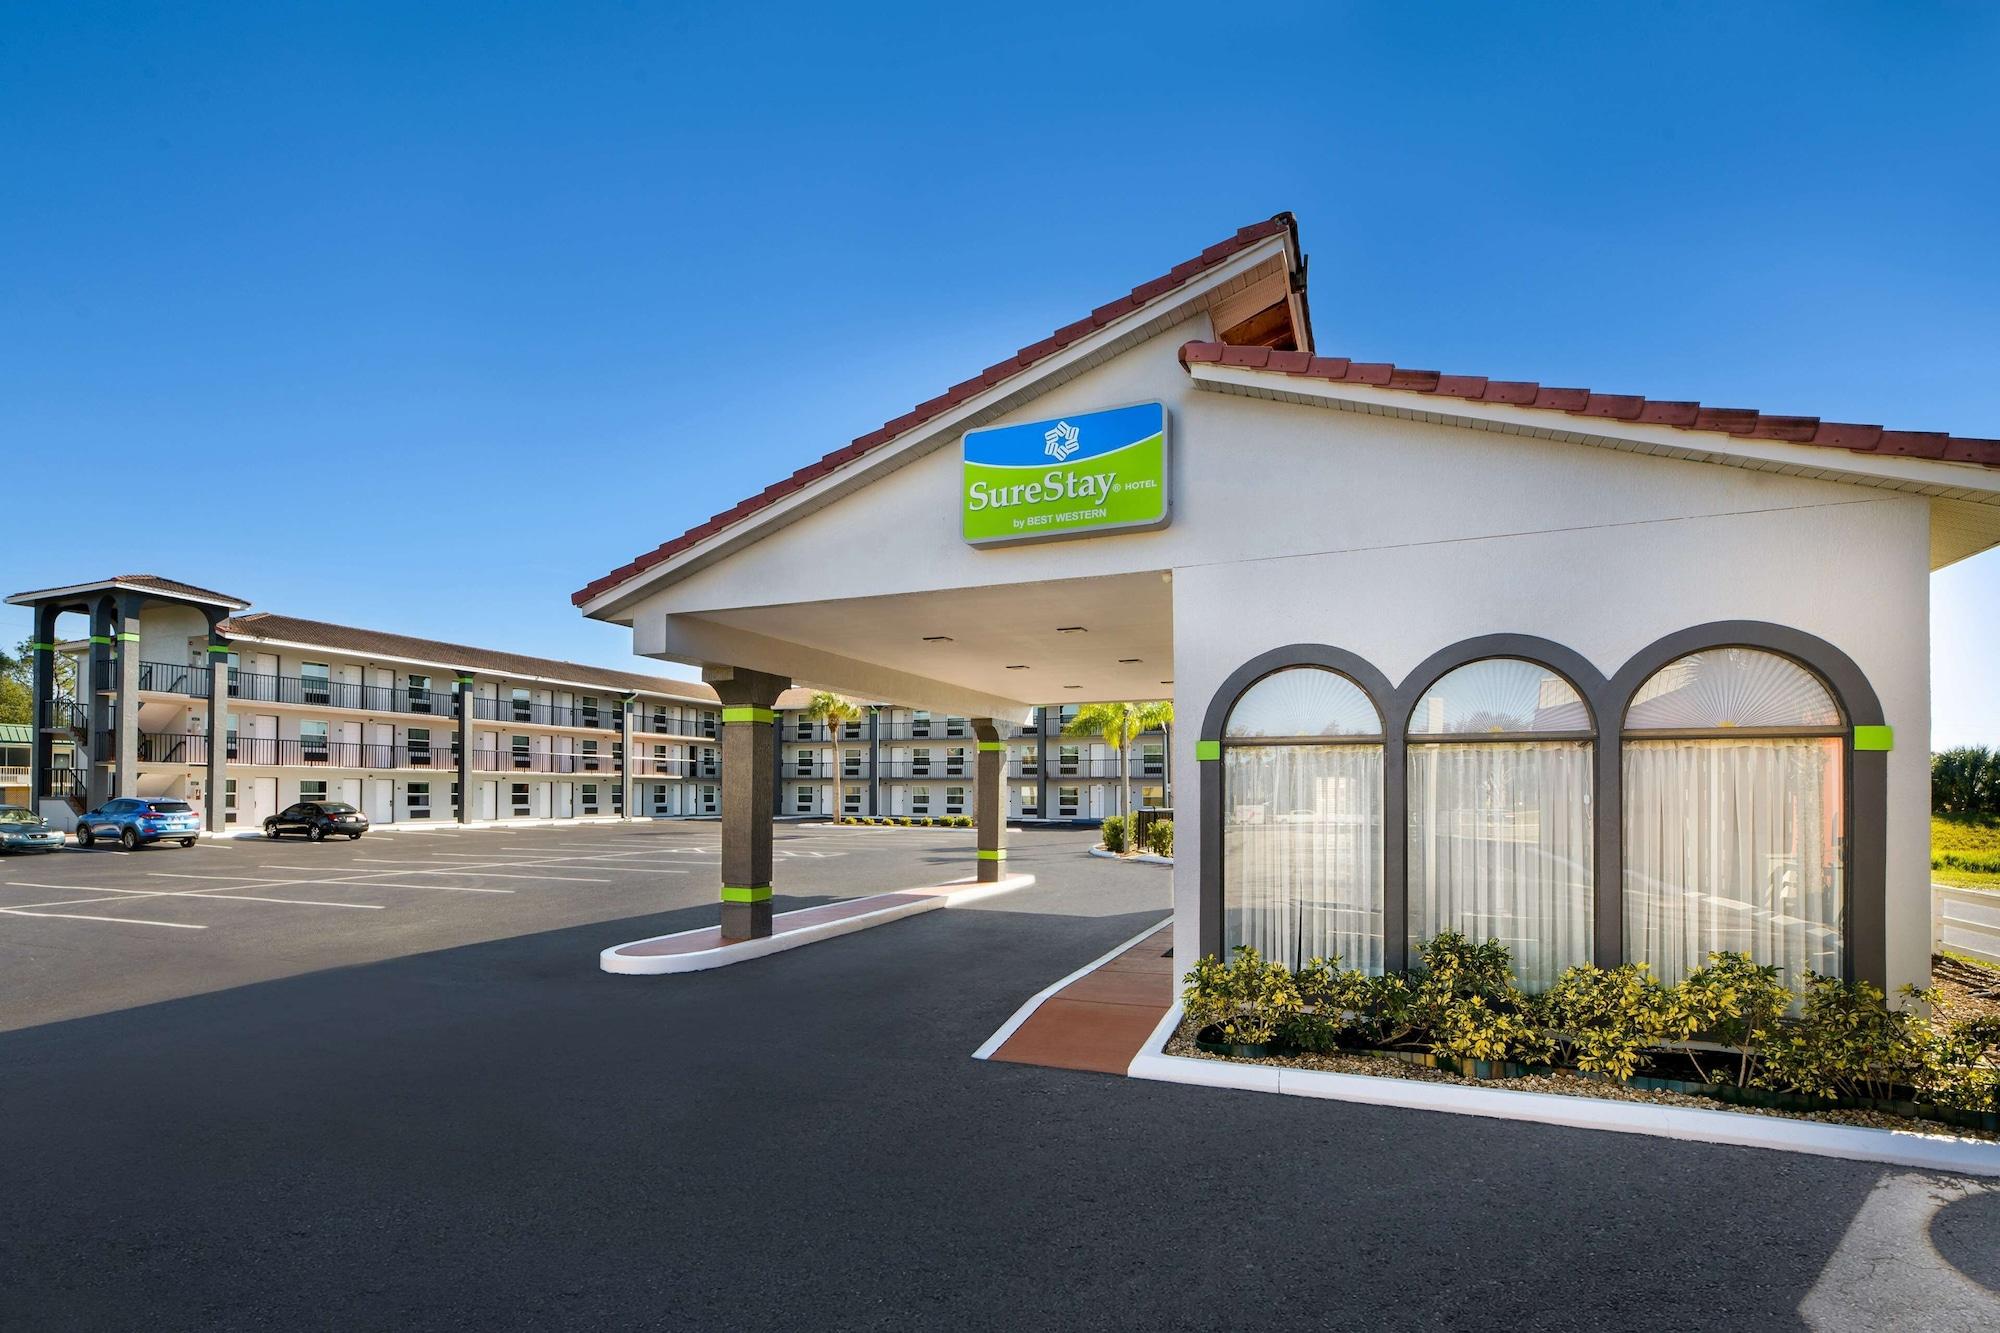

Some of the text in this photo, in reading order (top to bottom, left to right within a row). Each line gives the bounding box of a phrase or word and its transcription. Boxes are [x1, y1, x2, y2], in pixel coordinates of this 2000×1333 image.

[1124, 480, 1157, 491] HOTEL
[1013, 509, 1106, 528] by BEST WESTERN
